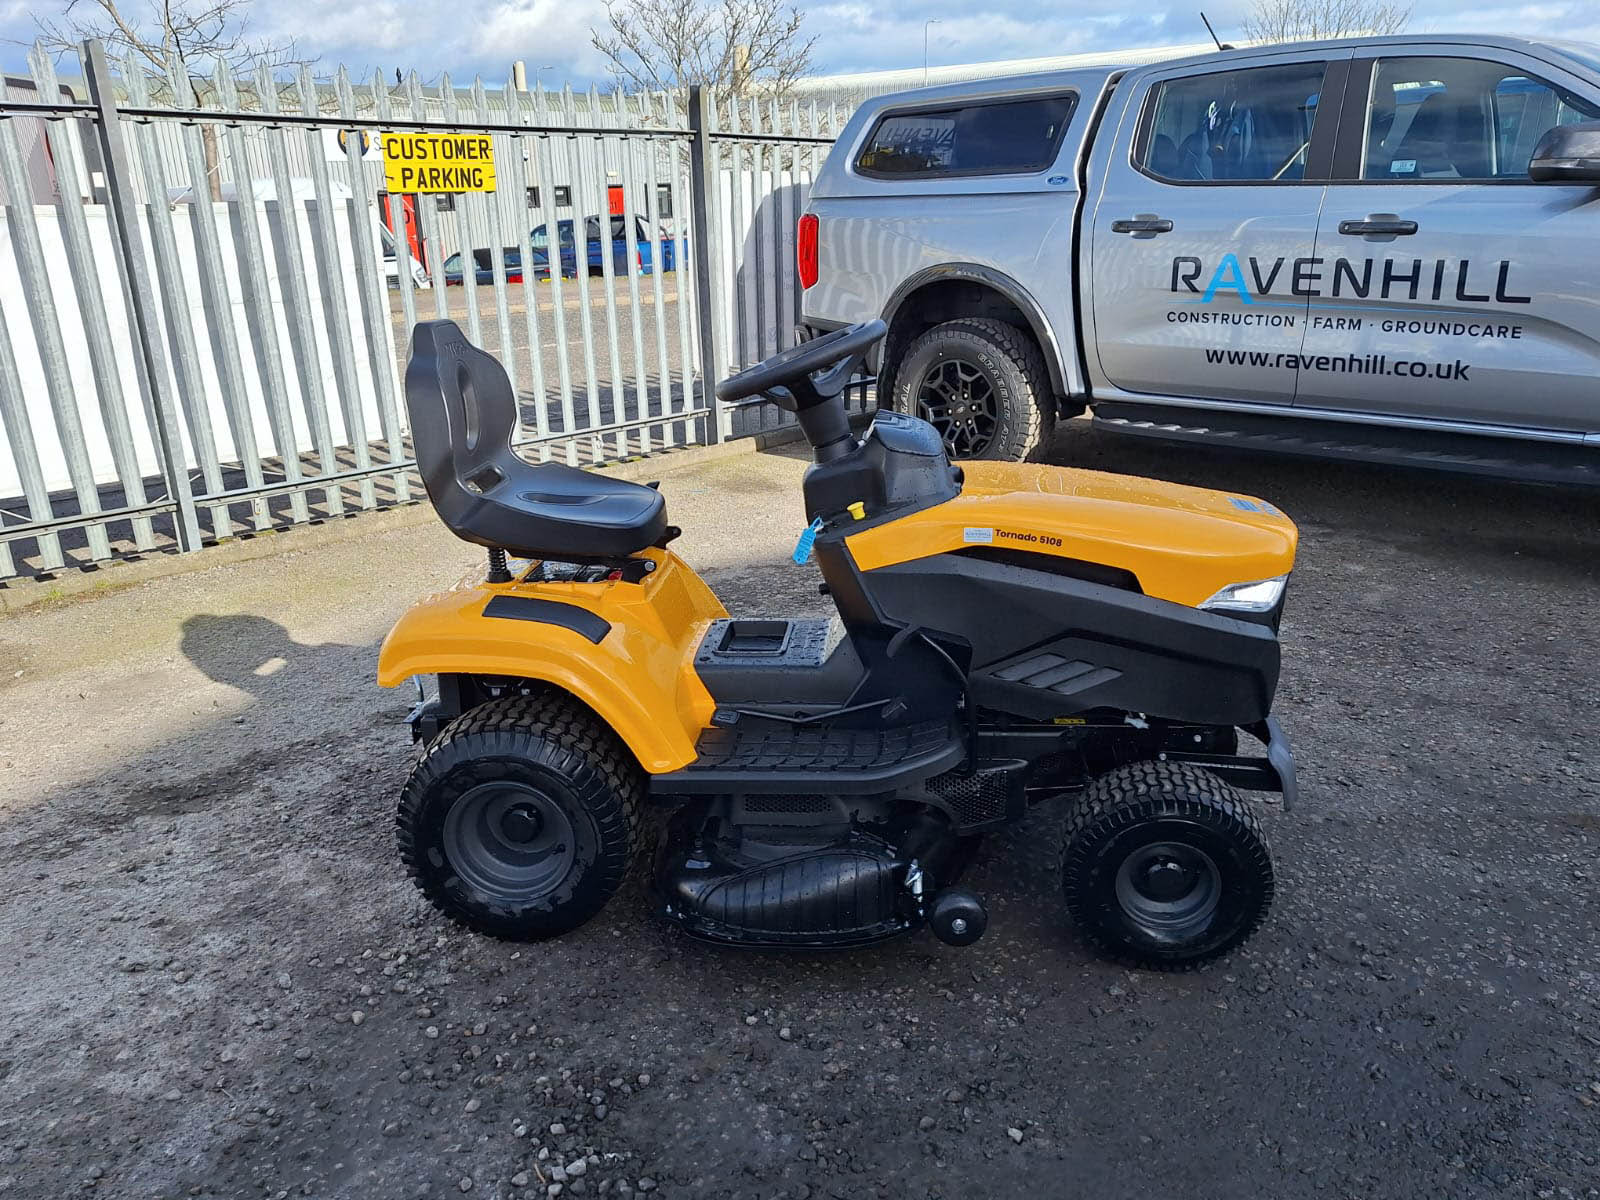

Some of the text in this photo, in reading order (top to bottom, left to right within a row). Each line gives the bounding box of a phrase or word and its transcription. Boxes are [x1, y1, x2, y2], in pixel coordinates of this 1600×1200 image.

[386, 138, 491, 160] CUSTOMER
[401, 167, 484, 189] PARKING
[1170, 253, 1532, 304] RAVENHILL
[1166, 311, 1523, 339] CONSTRUCTION FARM GROUNDCARE
[1205, 348, 1471, 382] www.ravenhill.co.uk
[995, 529, 1038, 543] Tornado
[1039, 535, 1063, 547] 5108
